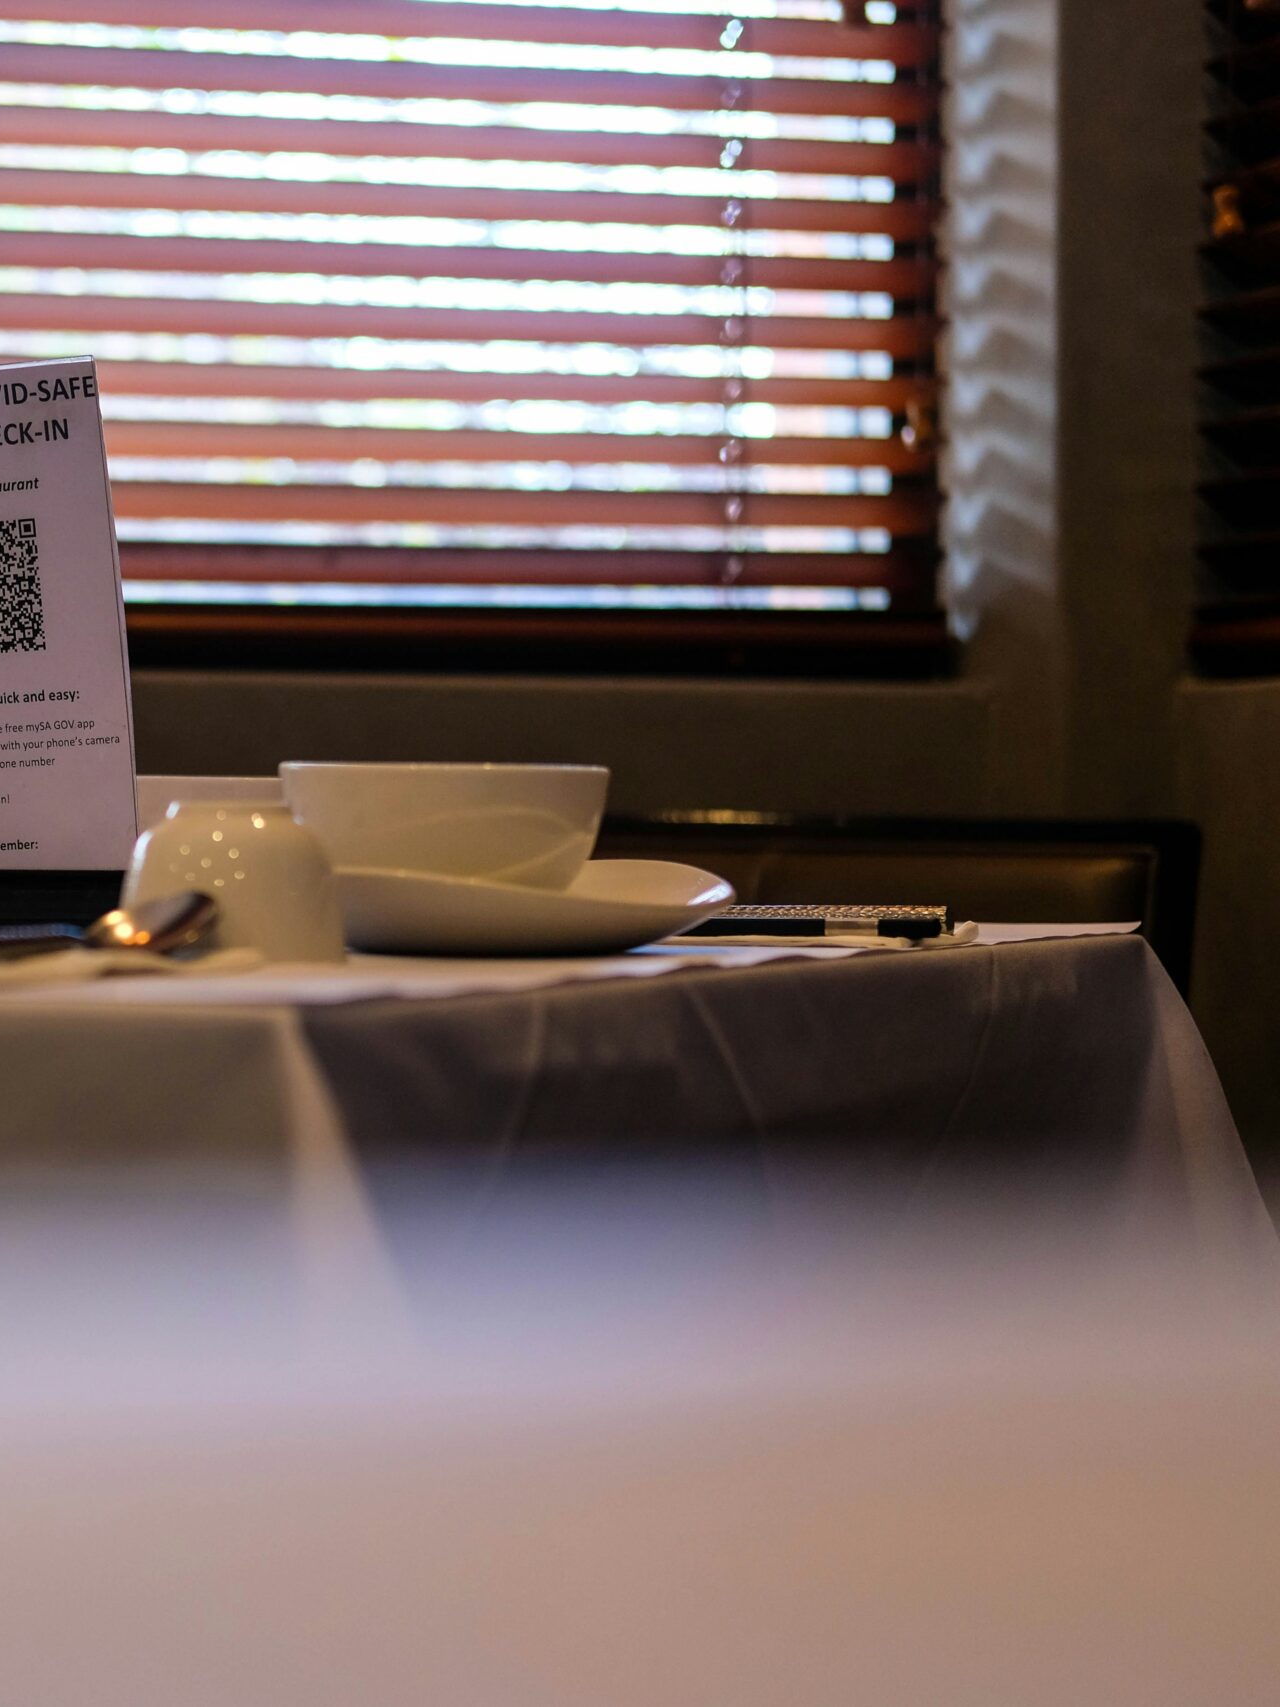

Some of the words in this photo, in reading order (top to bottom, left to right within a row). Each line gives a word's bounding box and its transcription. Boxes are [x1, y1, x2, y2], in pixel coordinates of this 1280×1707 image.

[22, 689, 45, 703] and
[48, 689, 80, 702] easy:
[5, 723, 23, 733] free
[26, 721, 52, 733] mySA
[53, 719, 75, 730] GOV
[77, 720, 95, 731] app
[0, 740, 20, 751] with
[22, 740, 44, 751] your
[46, 736, 83, 749] phone’s
[85, 735, 120, 746] camera
[19, 756, 55, 768] number
